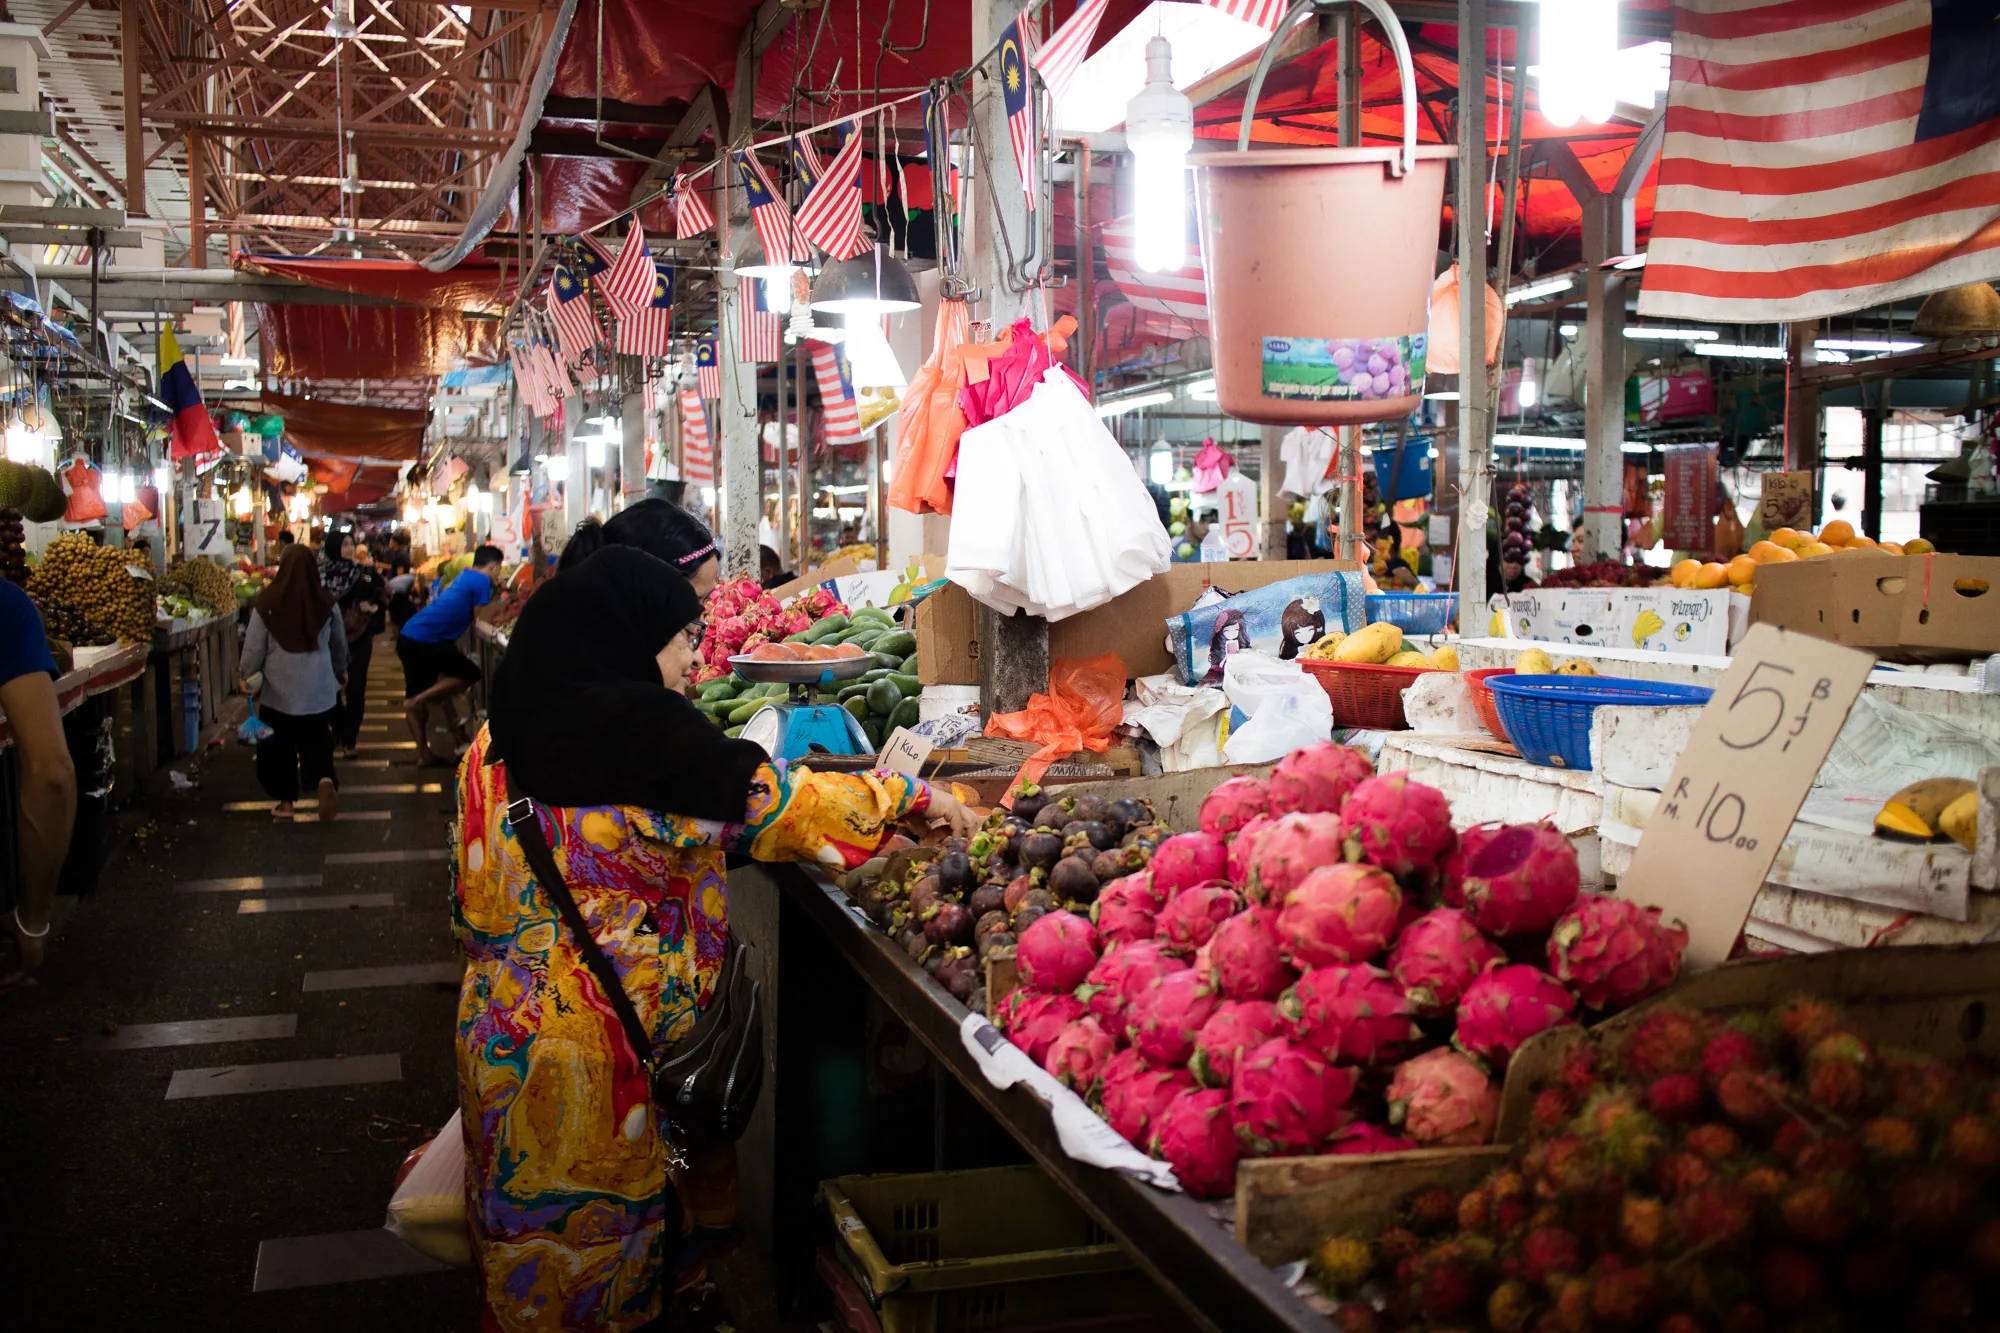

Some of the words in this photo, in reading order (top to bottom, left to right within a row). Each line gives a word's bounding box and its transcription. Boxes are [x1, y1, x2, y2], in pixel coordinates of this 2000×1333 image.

[1224, 490, 1237, 520] 1
[1763, 499, 1780, 519] 5
[198, 519, 221, 551] 7
[1225, 521, 1253, 557] 5
[1671, 599, 1709, 622] Cabana
[1719, 661, 1795, 750] 5
